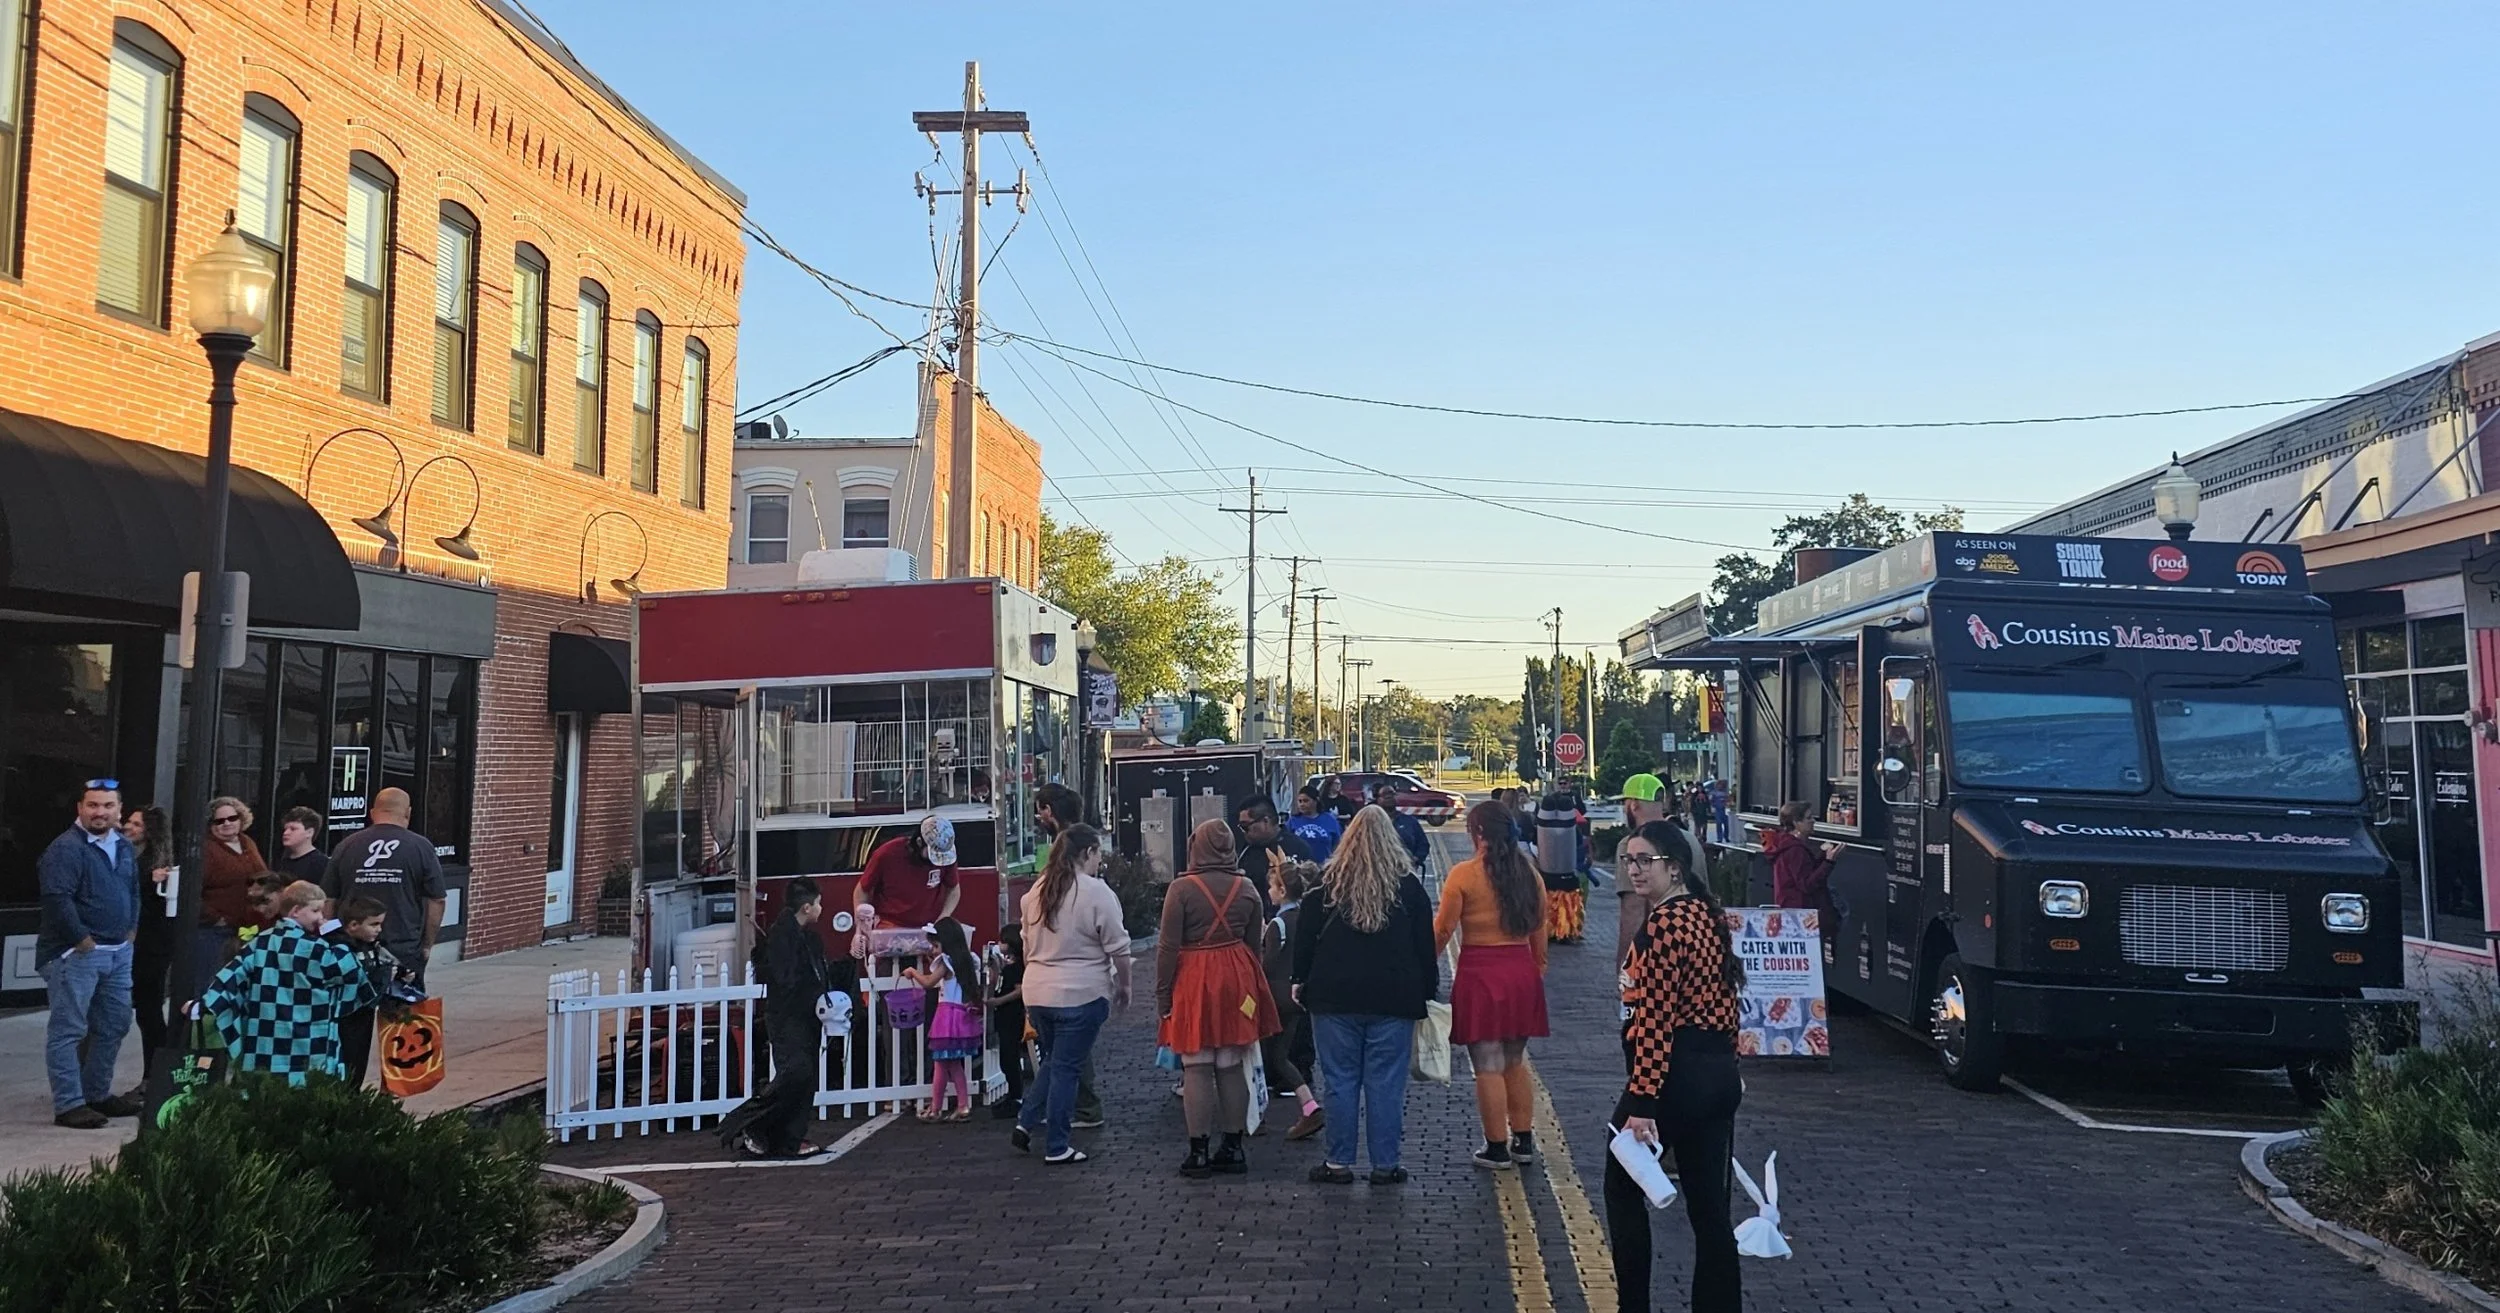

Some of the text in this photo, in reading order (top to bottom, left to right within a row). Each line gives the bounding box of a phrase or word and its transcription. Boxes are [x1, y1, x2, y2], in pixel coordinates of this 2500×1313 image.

[1955, 540, 2016, 550] AS SEEN ON
[2056, 543, 2103, 560] SHARK
[1955, 557, 1976, 566] abc
[1978, 563, 2020, 571] AMERICA
[2152, 554, 2188, 572] food
[2058, 559, 2106, 579] TANK
[2236, 574, 2288, 586] TODAY
[2002, 622, 2302, 655] Cousins Maine Lobster
[1556, 743, 1583, 755] STOP
[343, 754, 357, 792] H
[331, 797, 365, 811] HARPRO
[2057, 823, 2351, 846] Cousins Maine Lobster
[363, 839, 401, 868] JS
[1741, 941, 1775, 955] CATER
[1778, 941, 1807, 955] WITH
[1763, 957, 1810, 971] COUSINS
